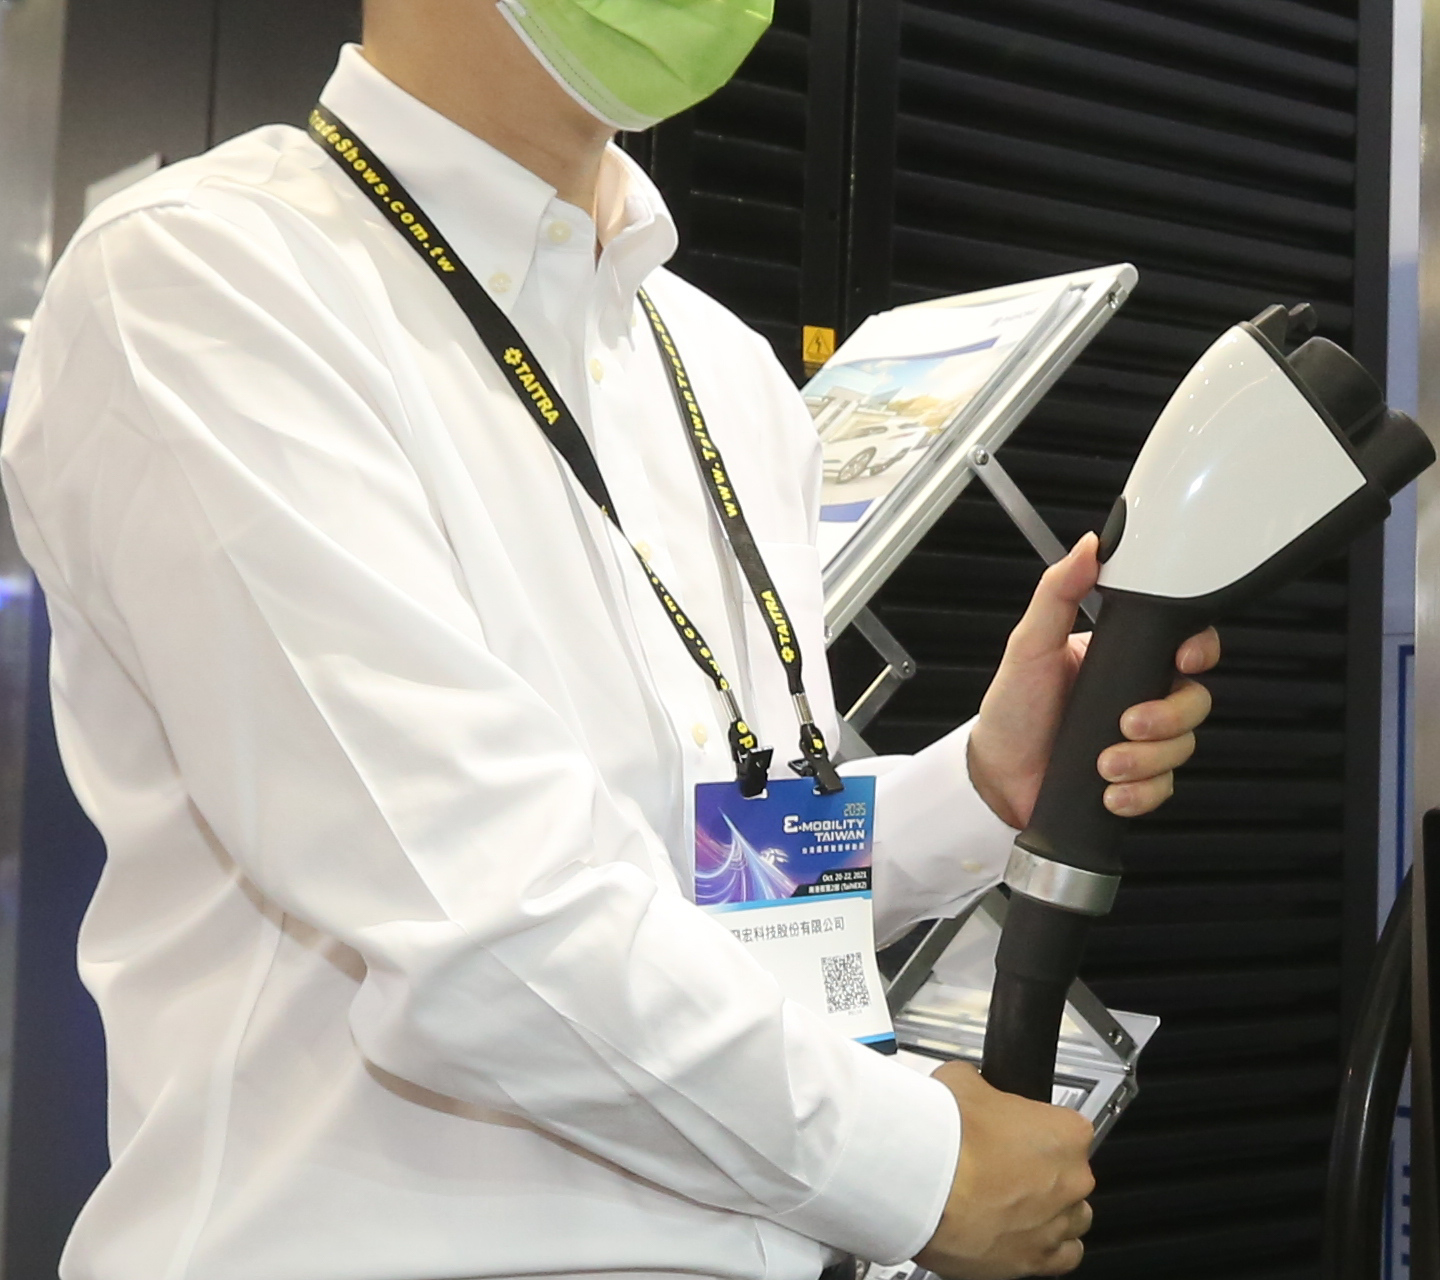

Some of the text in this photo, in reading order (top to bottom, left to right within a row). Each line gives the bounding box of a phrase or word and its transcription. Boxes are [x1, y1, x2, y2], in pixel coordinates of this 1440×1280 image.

[514, 360, 560, 426] TAITRA
[761, 589, 791, 646] TAITRA
[813, 829, 865, 843] TAIWAN
